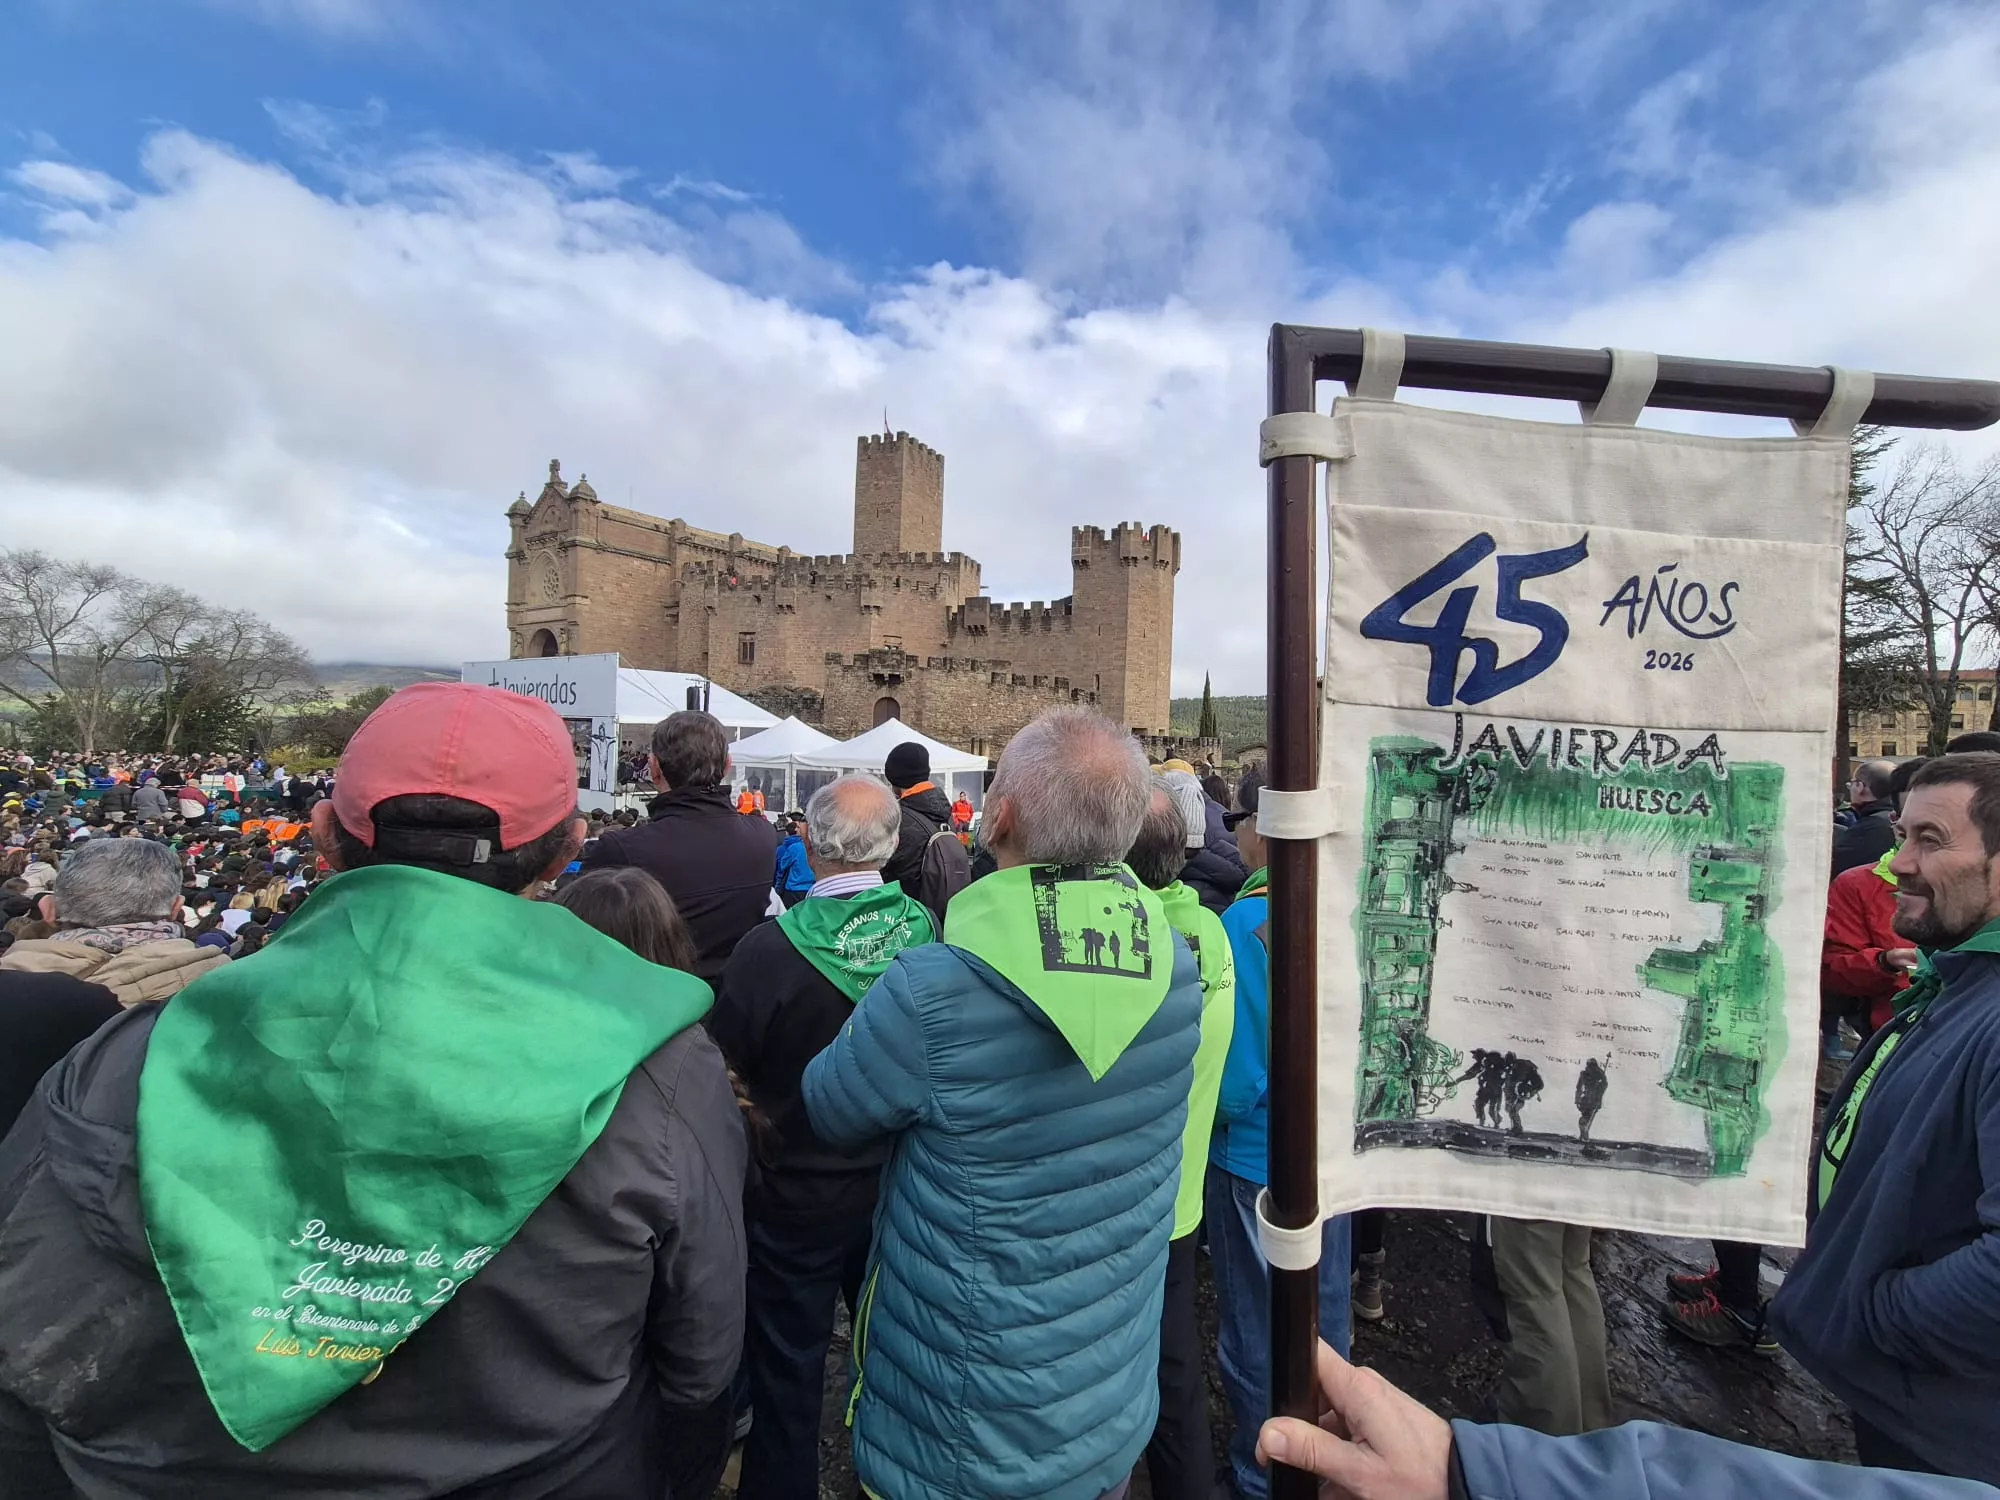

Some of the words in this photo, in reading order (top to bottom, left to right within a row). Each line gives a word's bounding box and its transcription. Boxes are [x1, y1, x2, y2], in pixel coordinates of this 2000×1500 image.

[1360, 530, 1589, 707] 45
[1600, 562, 1740, 640] AÑOS
[1643, 649, 1694, 672] 2026
[1437, 712, 1728, 778] JAVIERADA
[1600, 784, 1713, 818] HUESCA
[290, 1218, 408, 1266] Peregrino
[416, 1243, 444, 1268] de
[282, 1261, 413, 1304] Javierada
[252, 1306, 271, 1320] en
[274, 1305, 293, 1321] el
[295, 1304, 380, 1333] Bicentenario
[382, 1319, 400, 1334] de
[256, 1328, 302, 1357] Luis
[308, 1336, 385, 1362] Javier
